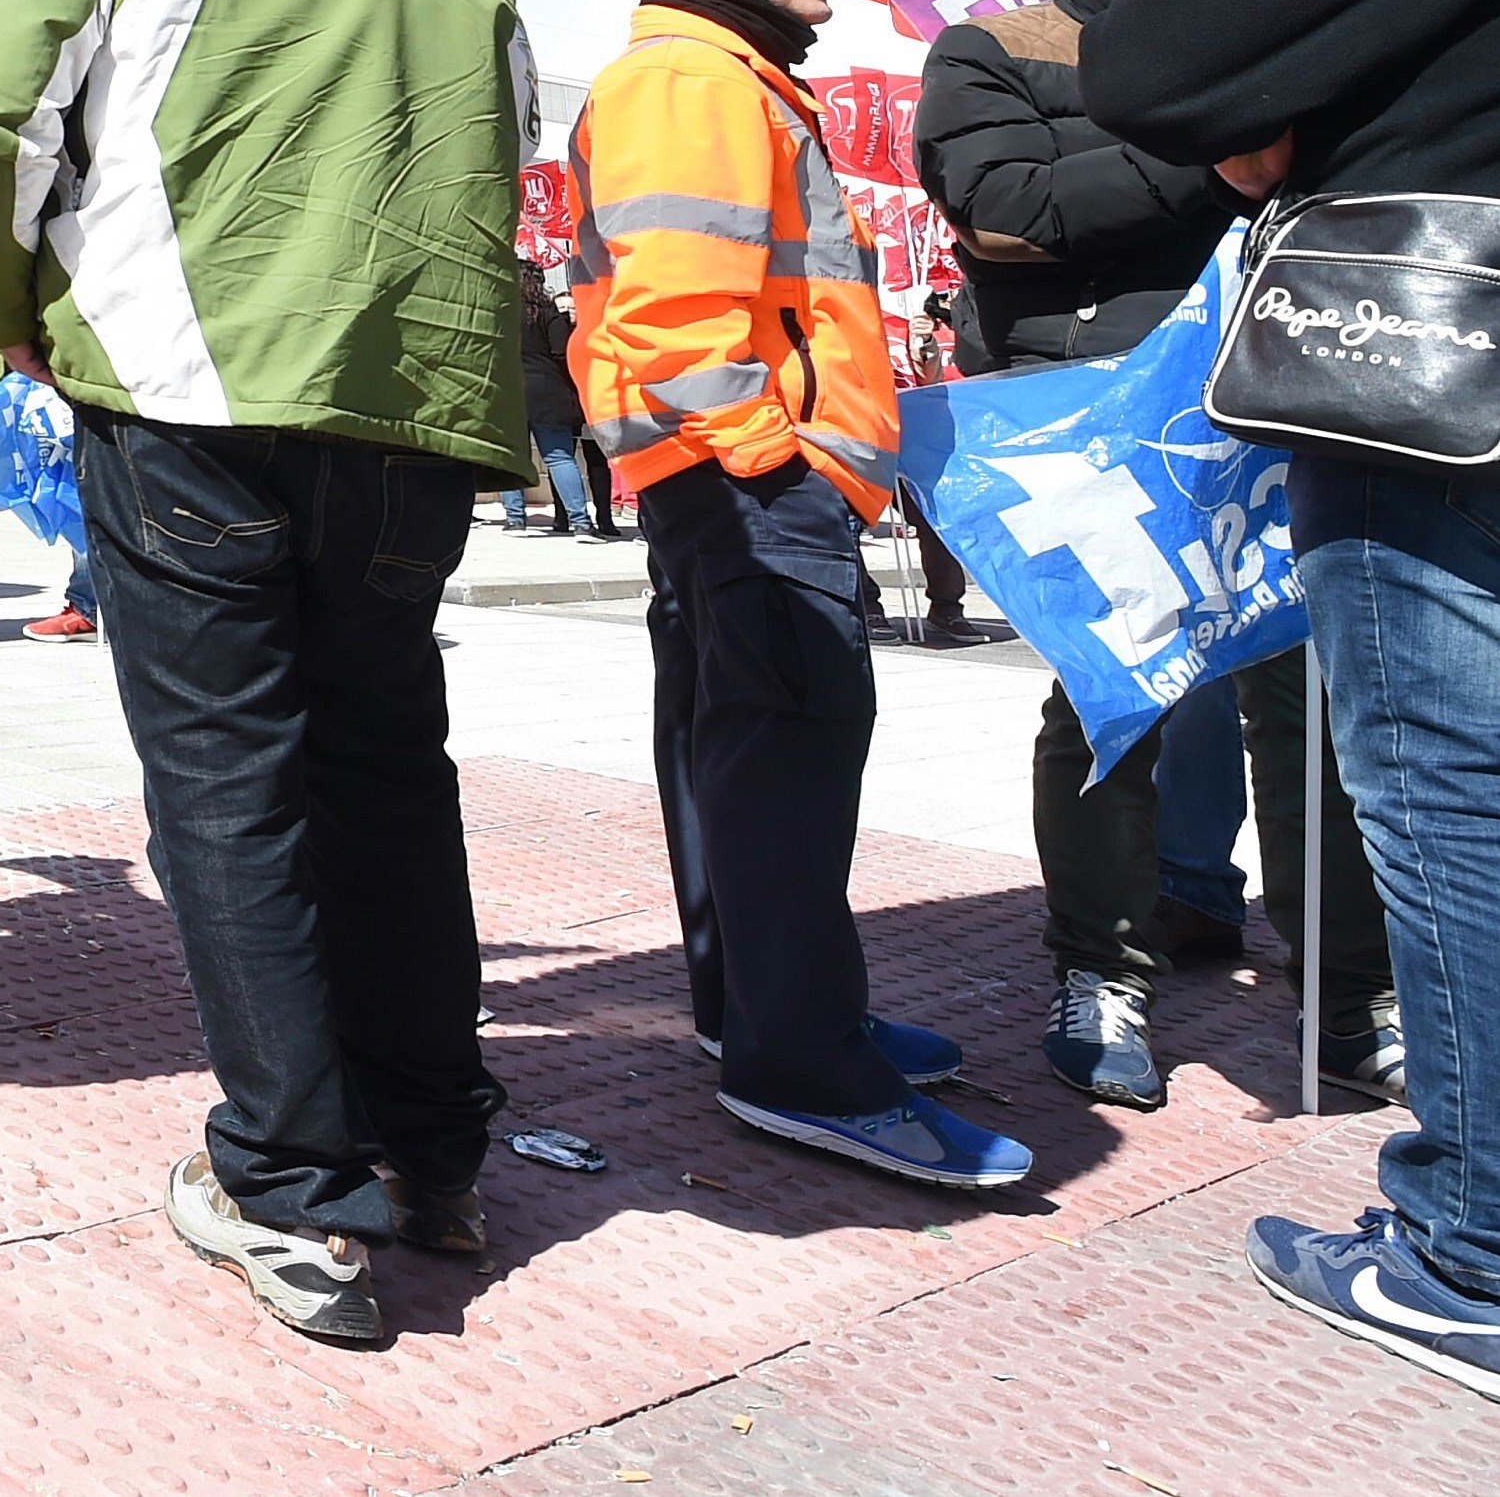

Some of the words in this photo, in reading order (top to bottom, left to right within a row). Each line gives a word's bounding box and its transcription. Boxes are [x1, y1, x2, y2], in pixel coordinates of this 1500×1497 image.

[1253, 286, 1343, 338] Pepe
[1339, 299, 1497, 351] Jeans
[1301, 344, 1402, 368] LONDON
